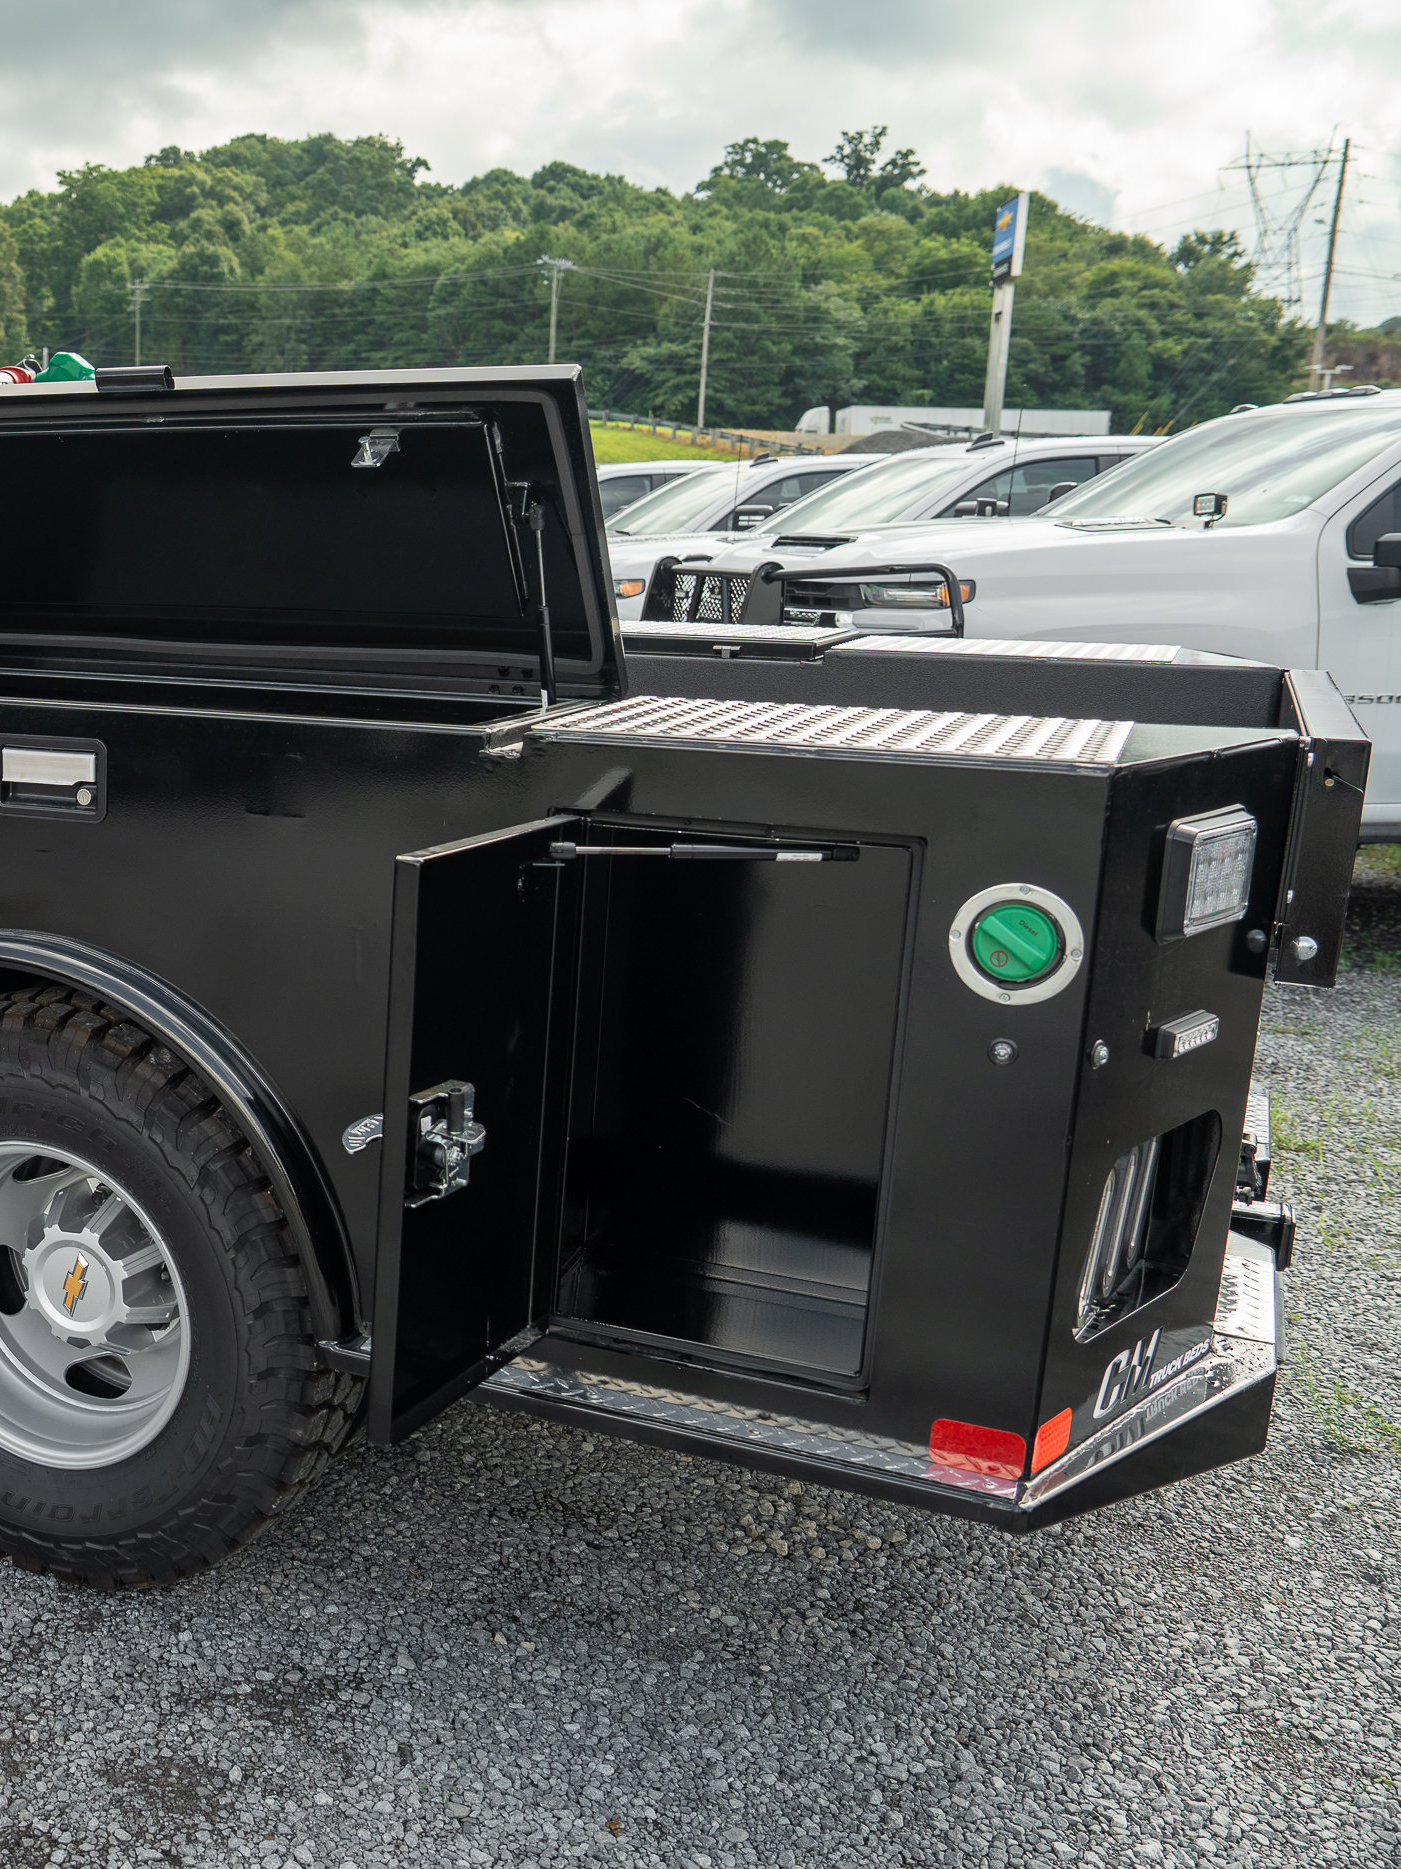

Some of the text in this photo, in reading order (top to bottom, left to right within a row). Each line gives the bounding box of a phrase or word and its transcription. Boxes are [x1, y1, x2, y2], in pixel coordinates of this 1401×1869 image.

[1018, 919, 1039, 937] Diesel
[1092, 1326, 1164, 1419] CM
[1149, 1338, 1211, 1389] TRUCK BEDS
